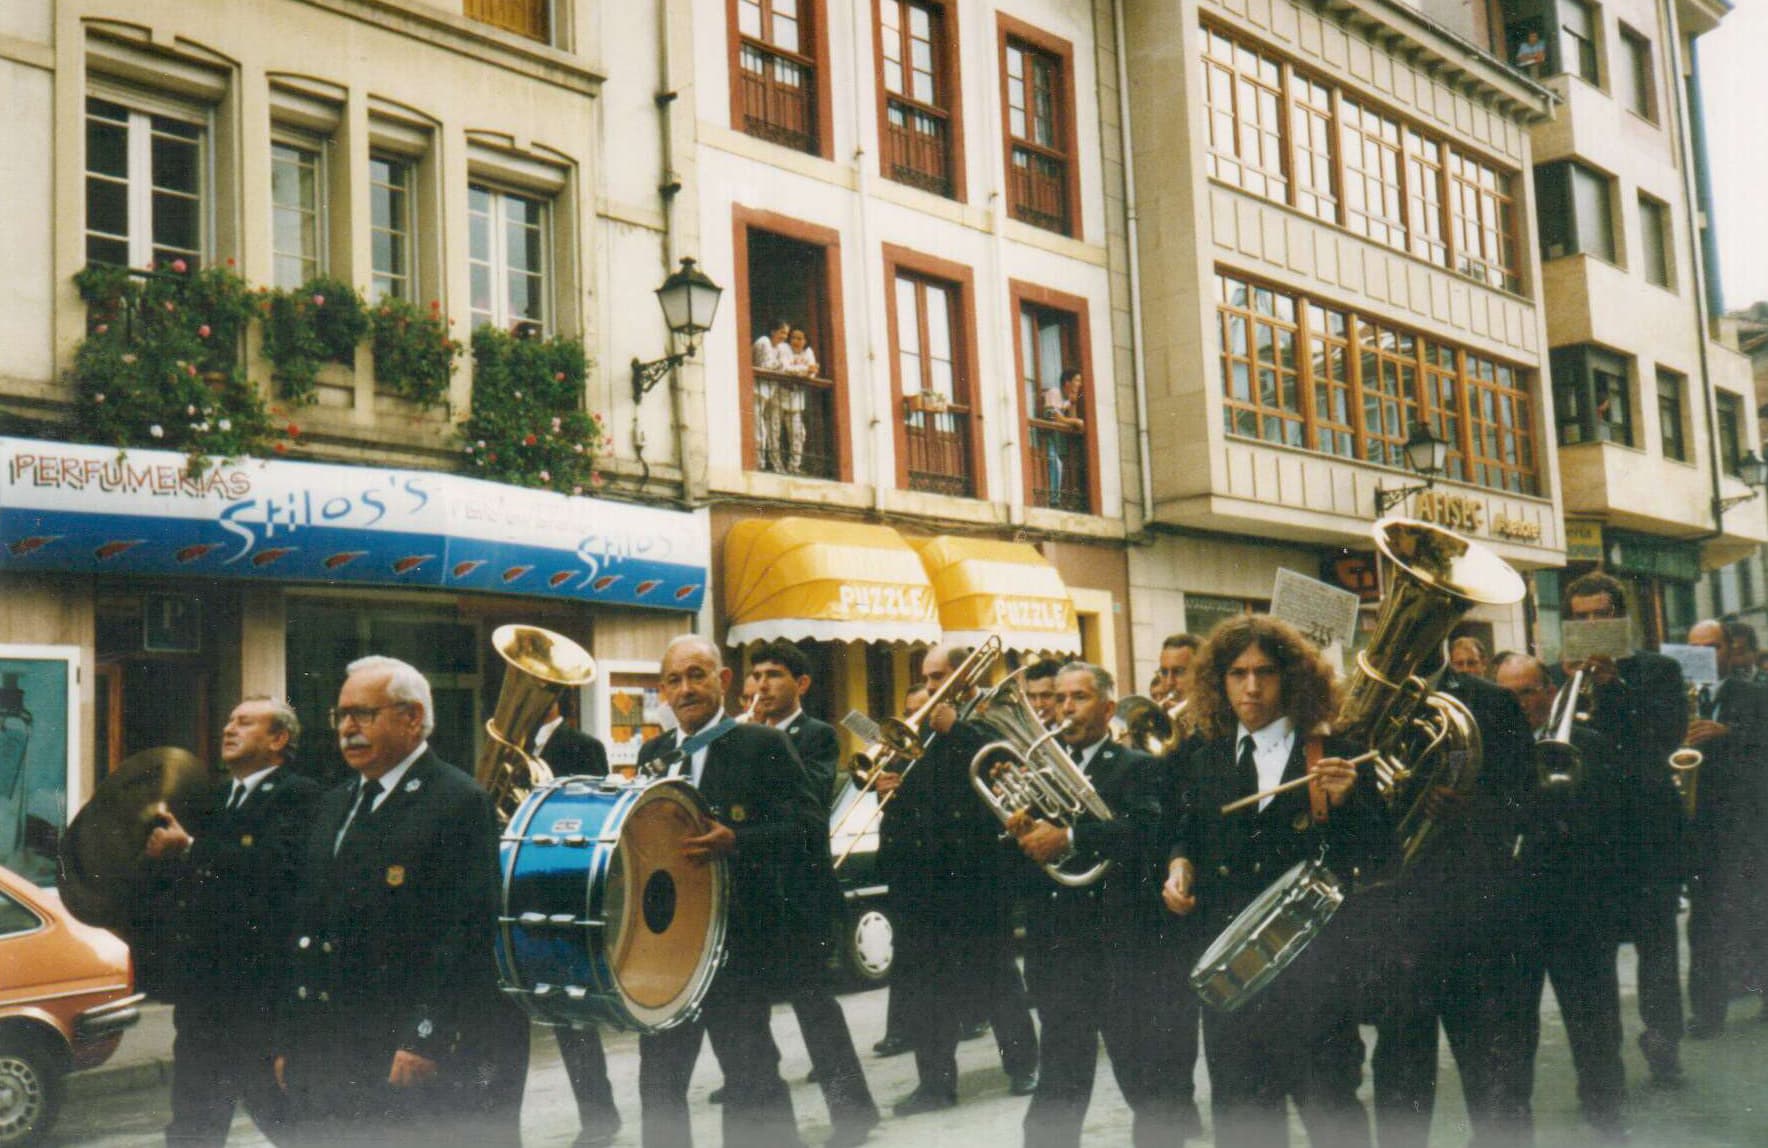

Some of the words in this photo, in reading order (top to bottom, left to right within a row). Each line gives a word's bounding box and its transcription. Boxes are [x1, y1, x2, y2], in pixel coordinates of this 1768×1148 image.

[9, 454, 251, 500] PERFUMERIAS
[839, 585, 925, 617] PUZZLE
[995, 597, 1067, 628] PUZZLE
